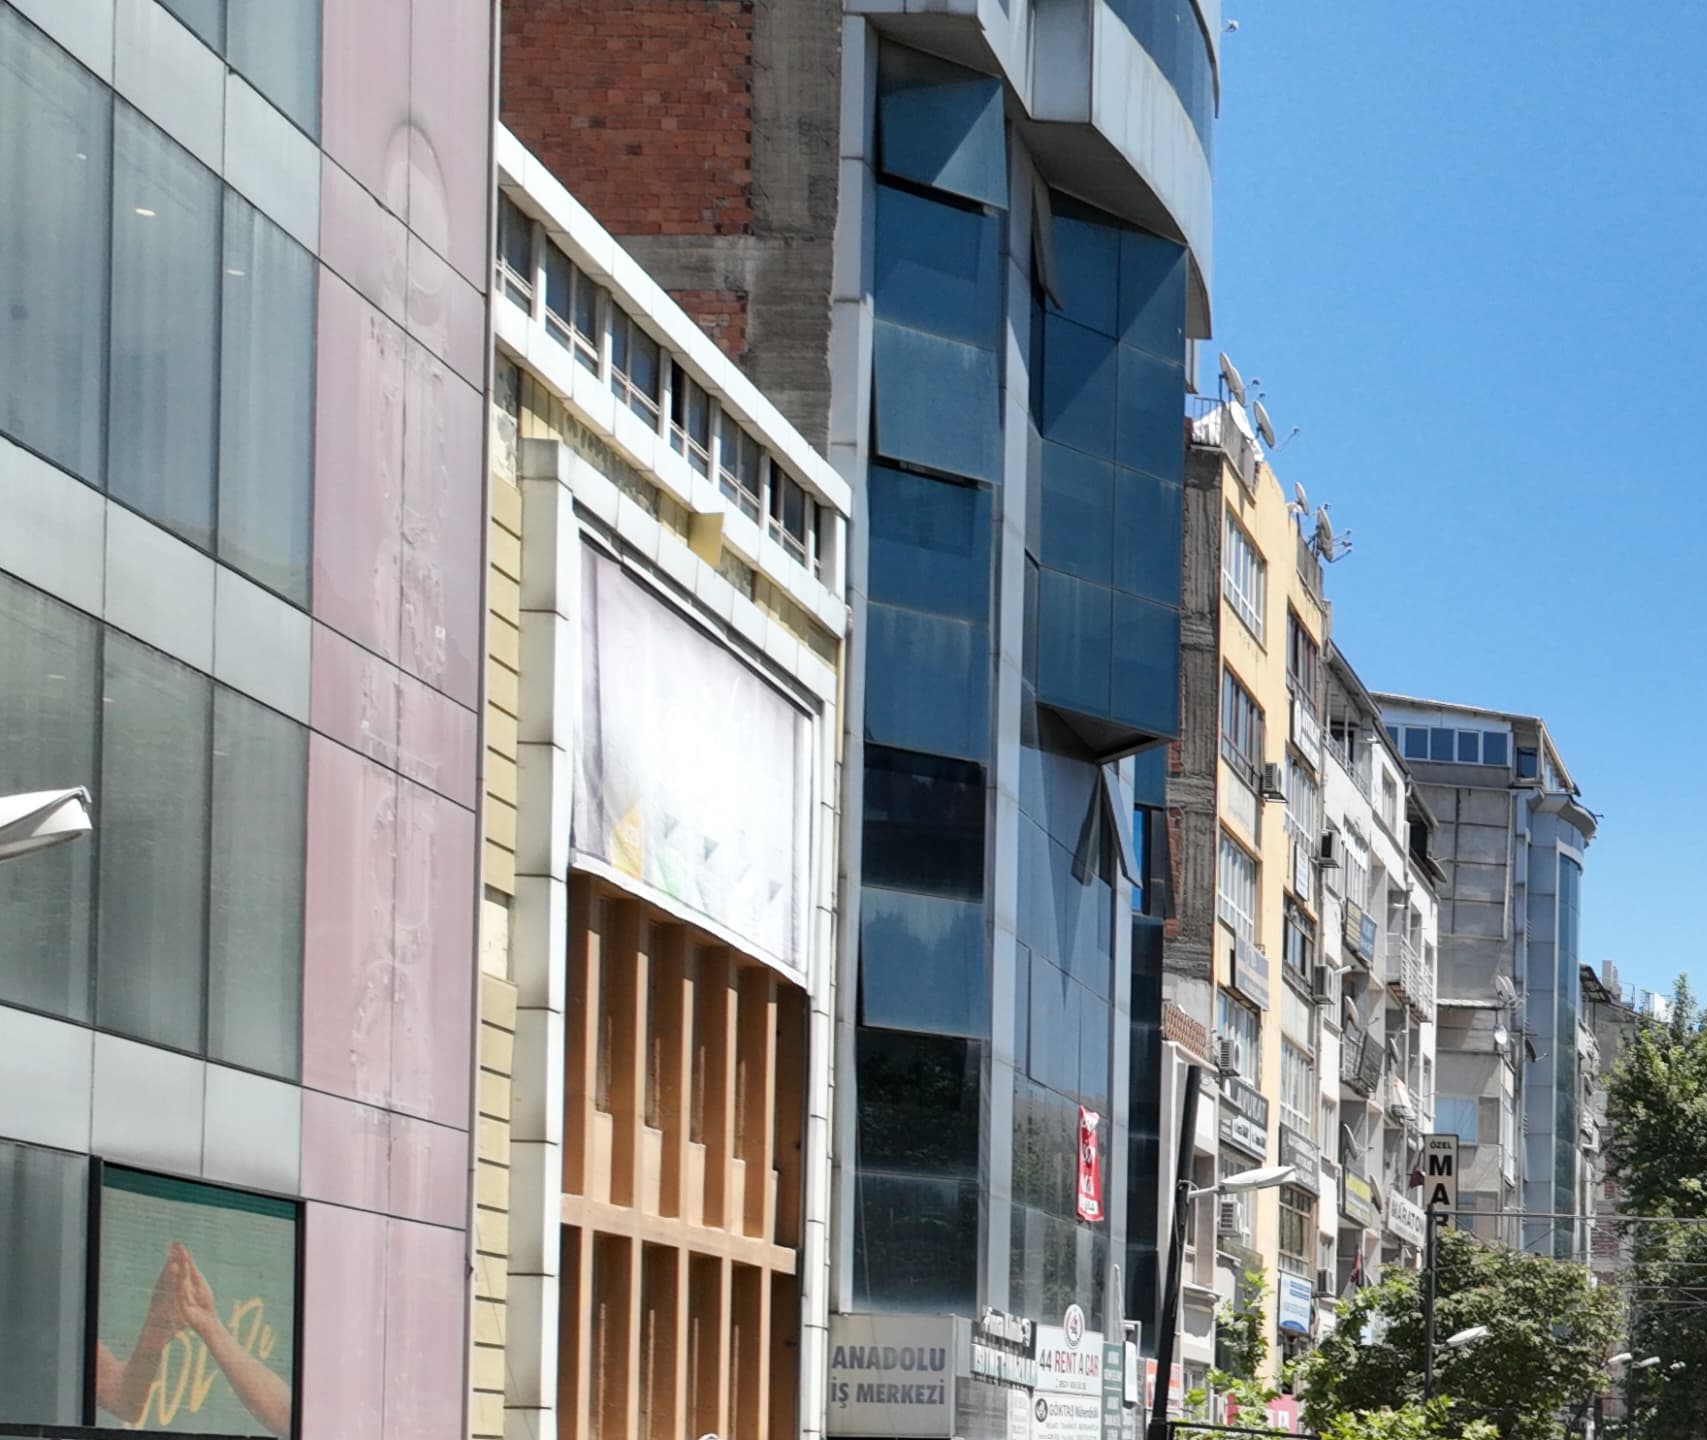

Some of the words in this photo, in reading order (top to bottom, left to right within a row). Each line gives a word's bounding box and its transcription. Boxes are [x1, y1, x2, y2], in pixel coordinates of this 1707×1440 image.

[1429, 1154, 1454, 1227] MAR
[832, 1345, 946, 1371] ANADOLU
[1054, 1350, 1077, 1374] RENT
[831, 1377, 849, 1409] İŞ
[856, 1379, 945, 1405] MERKEZİ
